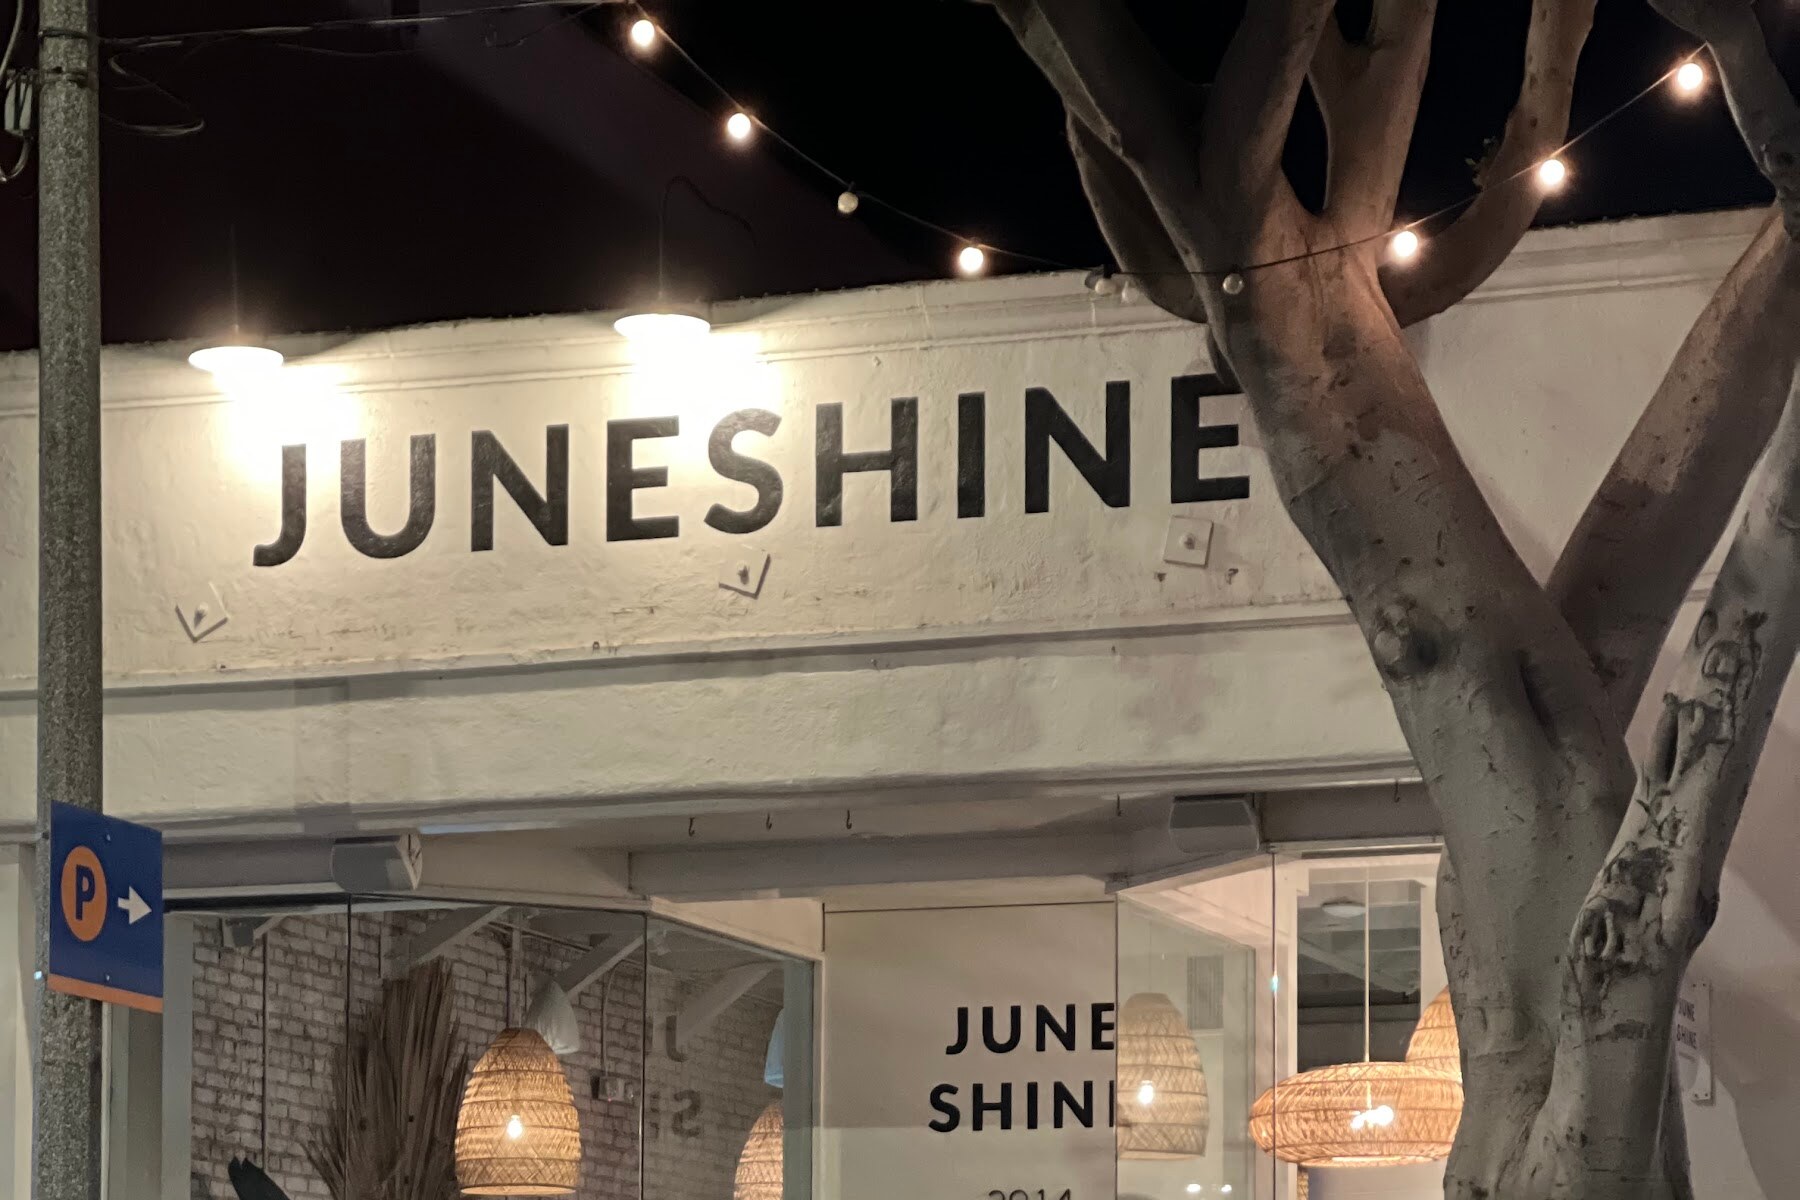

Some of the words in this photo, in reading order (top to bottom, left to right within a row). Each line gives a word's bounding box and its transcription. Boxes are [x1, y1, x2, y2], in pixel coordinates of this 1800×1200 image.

[253, 373, 1251, 567] JUNESHINE
[75, 864, 96, 921] P
[946, 1003, 1115, 1055] JUNE
[928, 1080, 1115, 1133] SHIN
